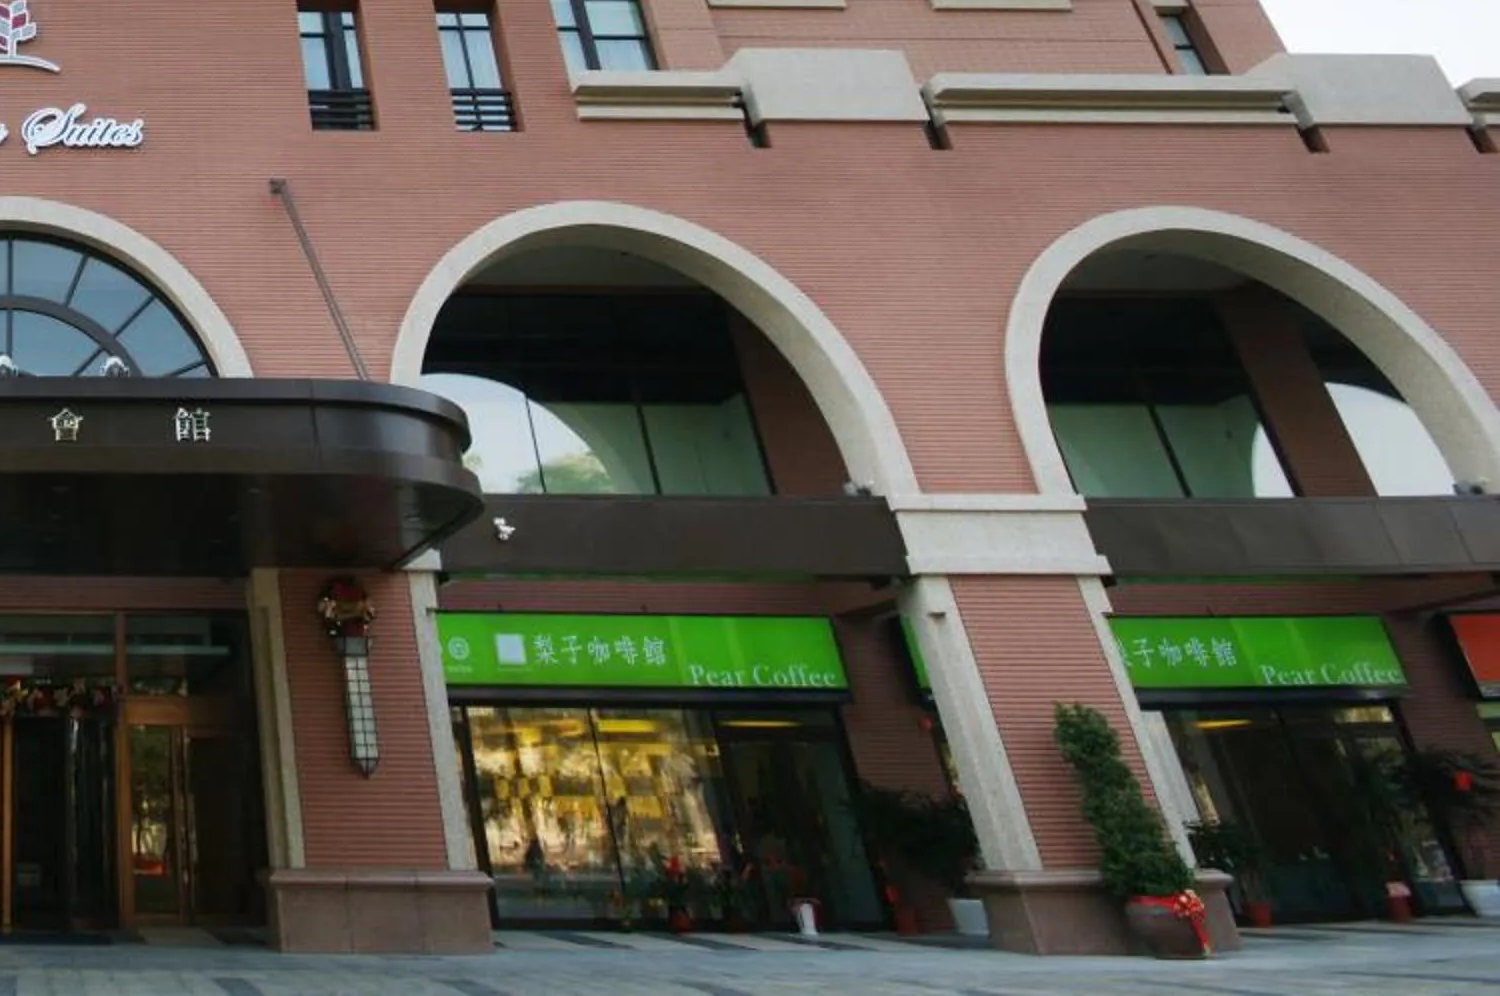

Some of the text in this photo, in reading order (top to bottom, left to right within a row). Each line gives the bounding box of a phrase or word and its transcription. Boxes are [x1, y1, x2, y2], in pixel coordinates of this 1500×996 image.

[21, 103, 145, 155] Suites
[533, 634, 667, 667] 梨子咖啡館
[688, 663, 837, 687] Pear Coffee
[1259, 660, 1407, 685] Pear Coffee
